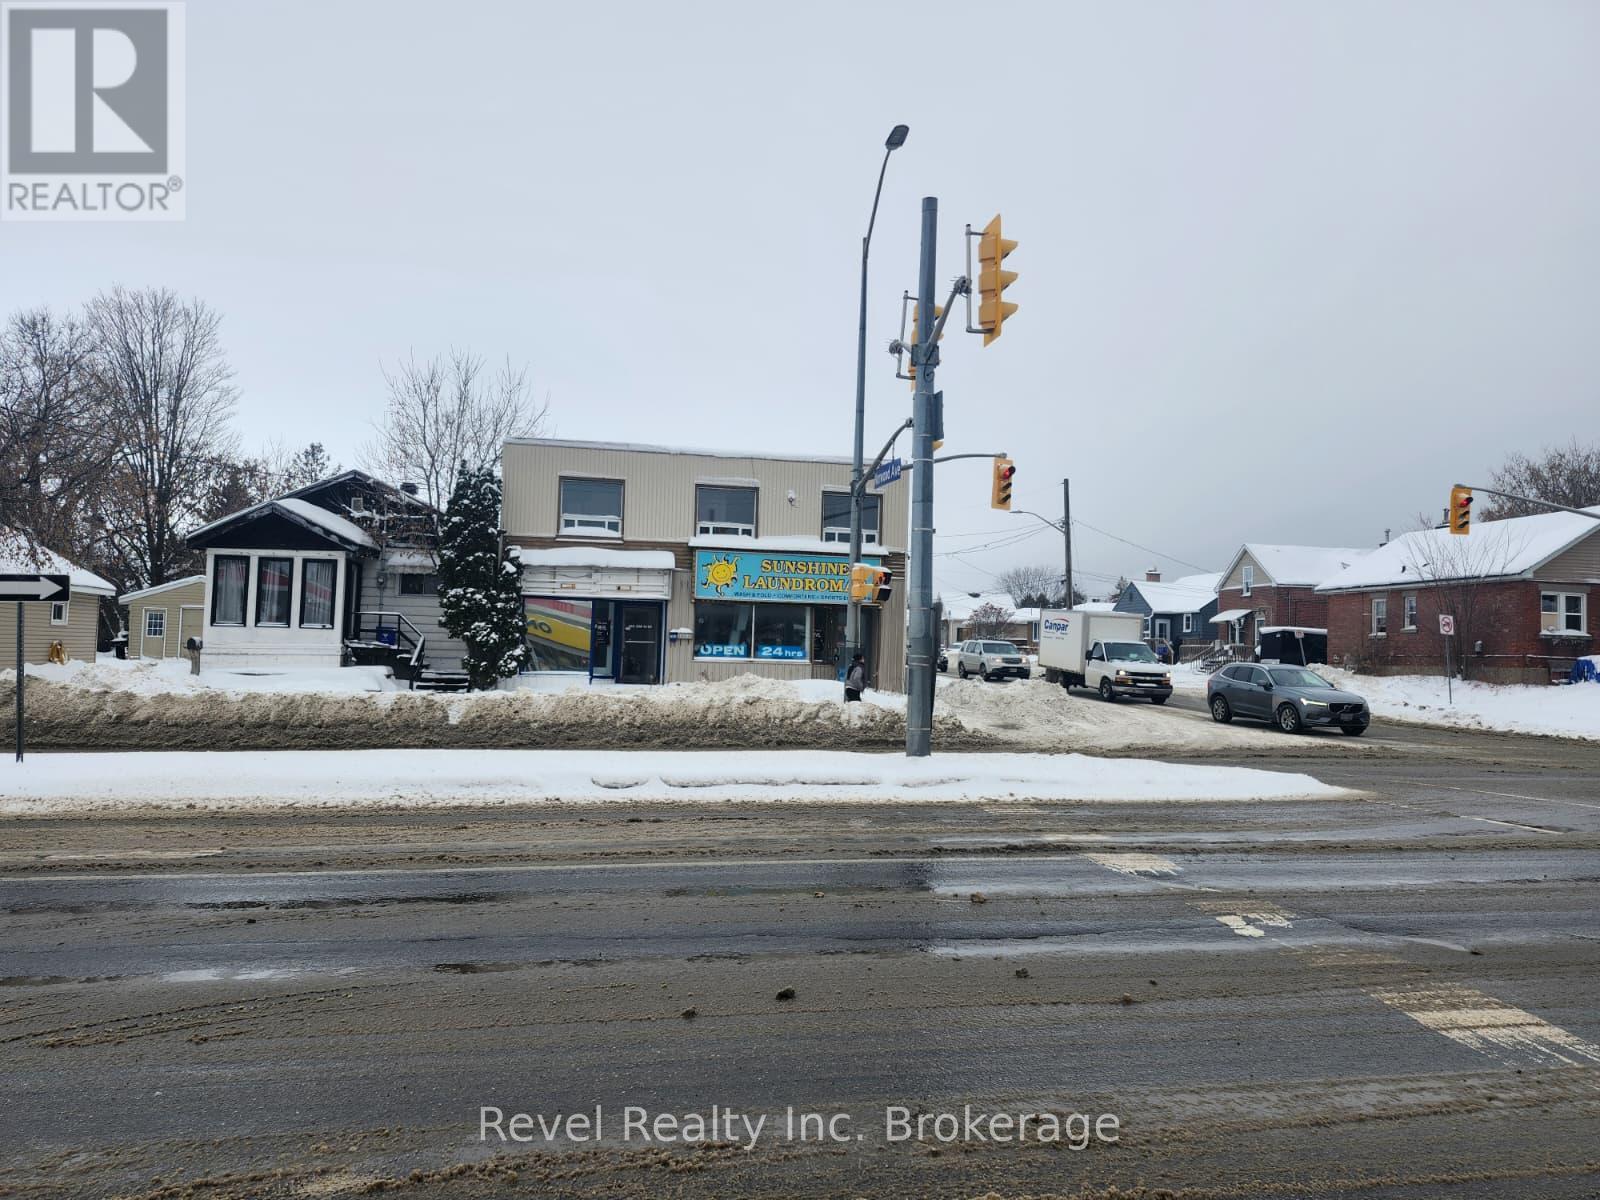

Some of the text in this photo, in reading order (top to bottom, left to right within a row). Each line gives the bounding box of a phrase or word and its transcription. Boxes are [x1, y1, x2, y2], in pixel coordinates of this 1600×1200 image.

[761, 559, 850, 575] SUNSHINE
[700, 645, 745, 656] OPEN
[761, 646, 803, 657] 24 hrs
